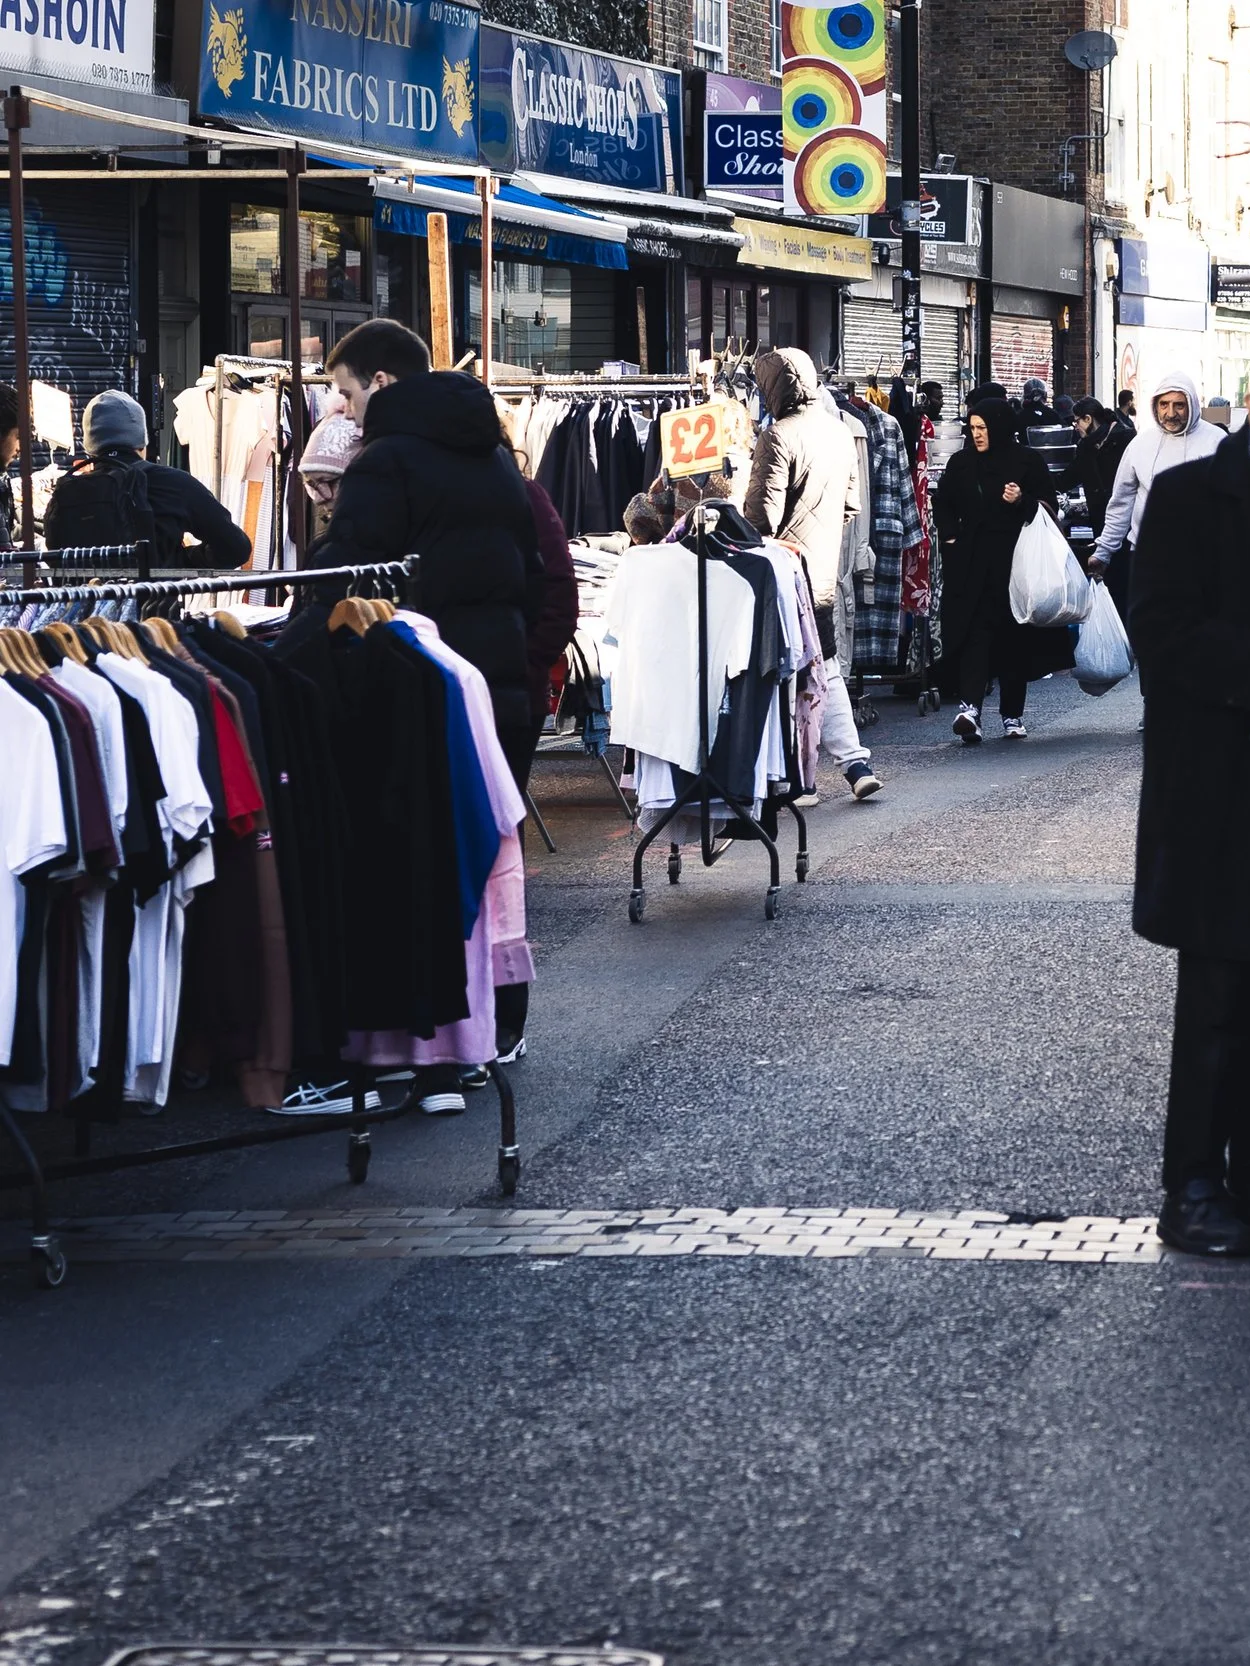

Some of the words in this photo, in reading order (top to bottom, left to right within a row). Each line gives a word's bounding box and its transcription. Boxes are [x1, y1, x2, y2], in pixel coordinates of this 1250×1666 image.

[429, 1, 443, 21] 020
[443, 5, 460, 26] 7375
[460, 9, 477, 30] 2706
[251, 50, 379, 124] FABRICS
[386, 79, 438, 132] LTD
[511, 47, 584, 131] CLASSIC
[587, 72, 638, 150] SHOES
[714, 123, 784, 148] Class
[569, 142, 598, 168] London
[723, 151, 784, 176] Sho
[920, 222, 944, 232] YCLES
[669, 413, 718, 464] £2
